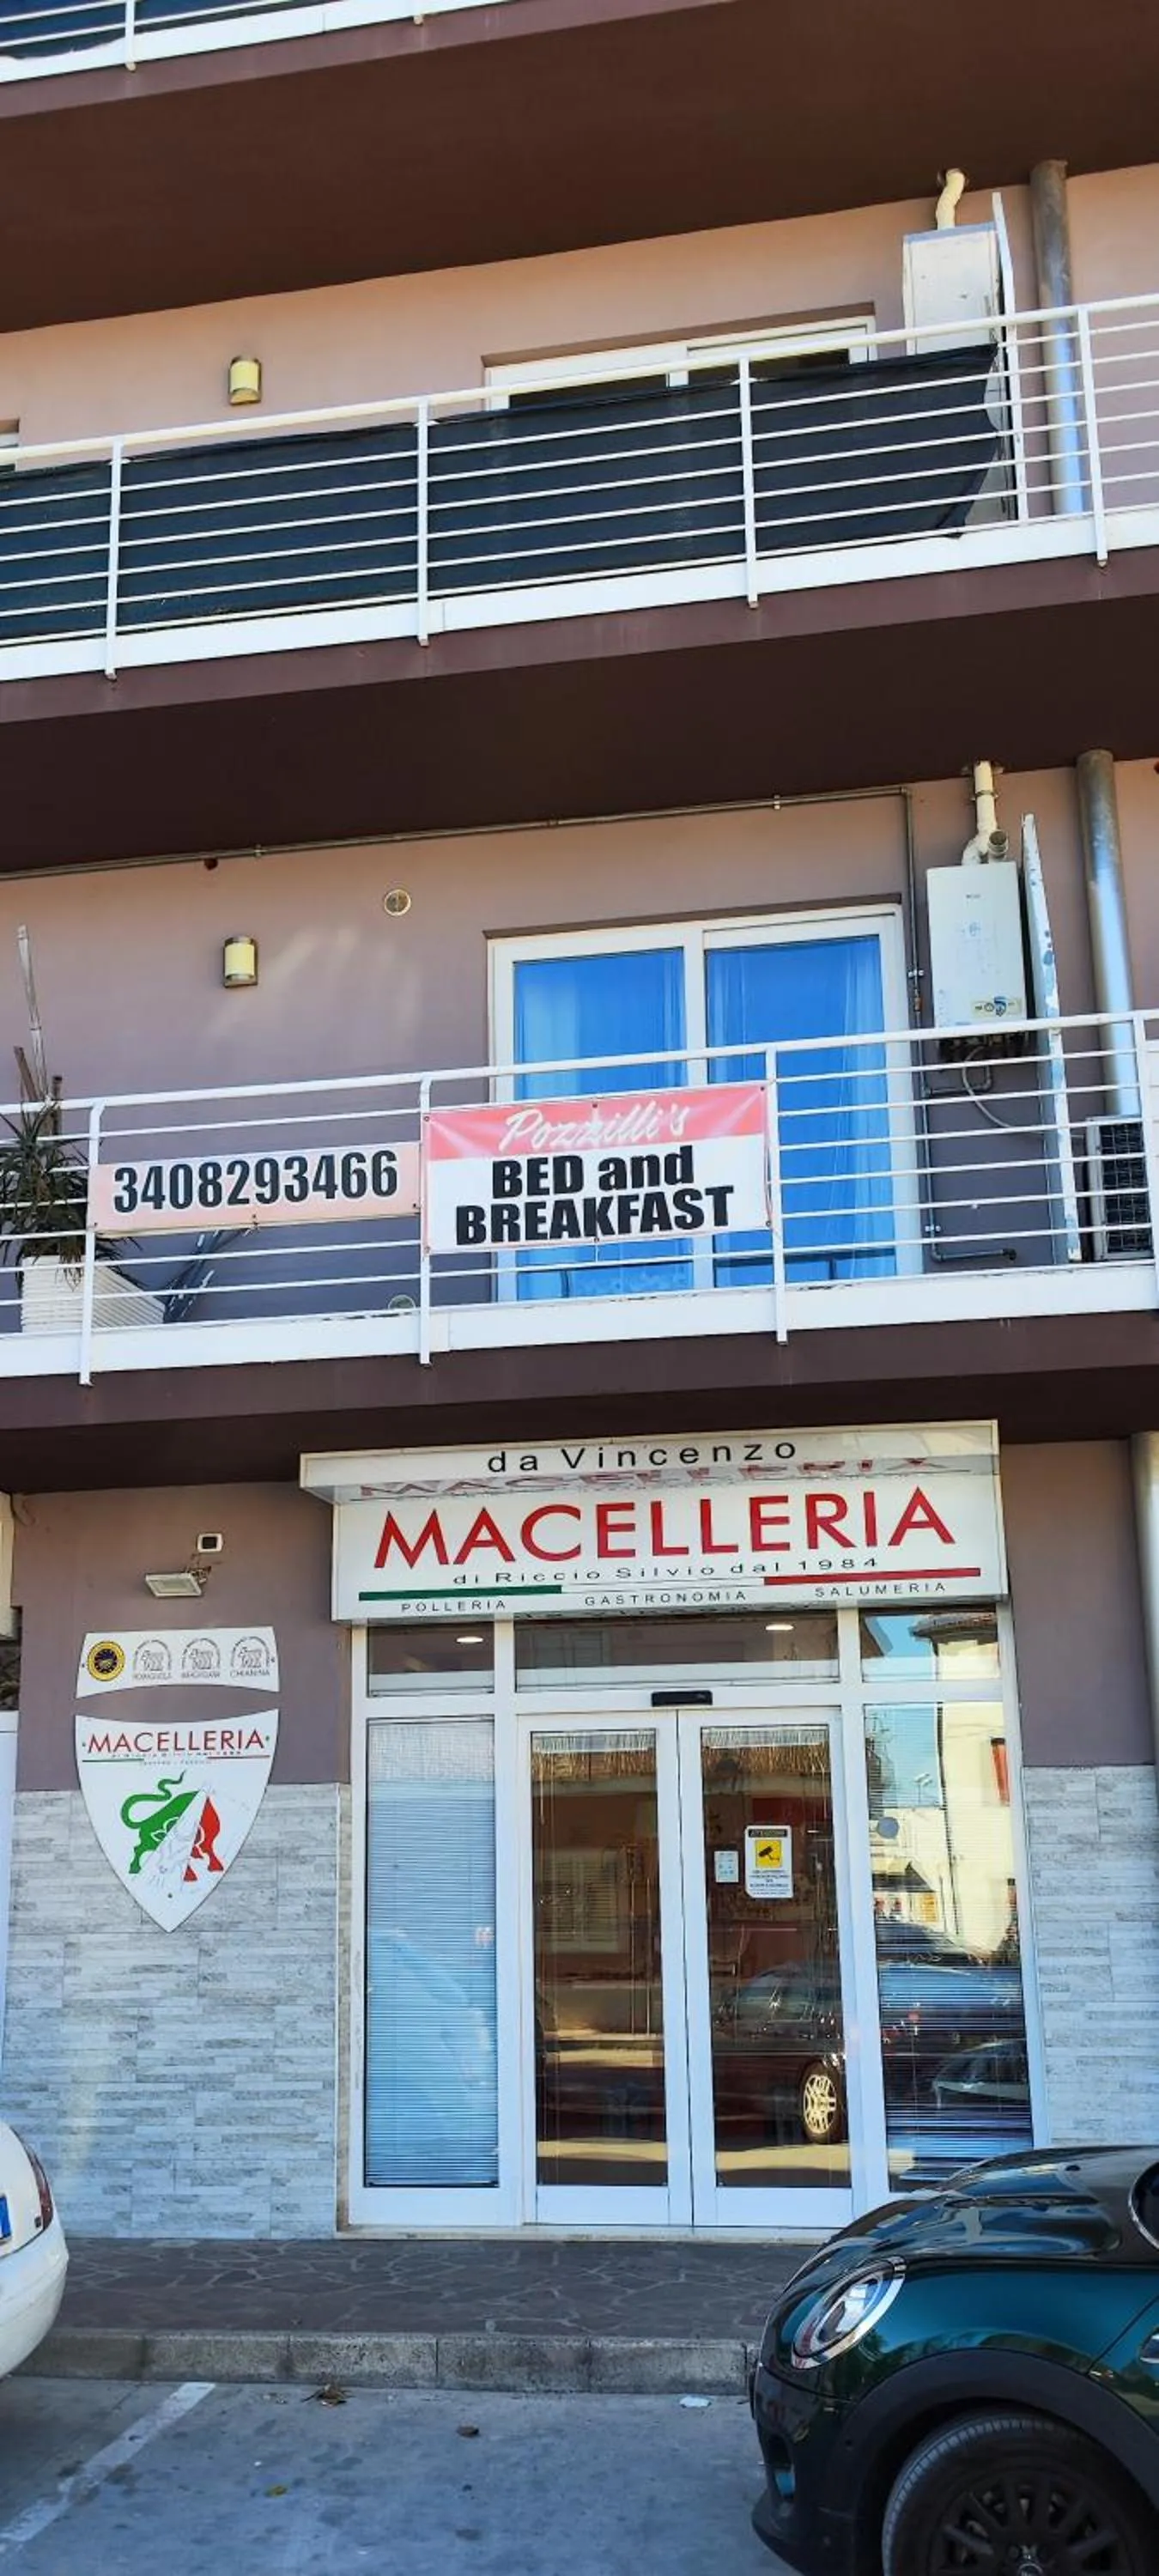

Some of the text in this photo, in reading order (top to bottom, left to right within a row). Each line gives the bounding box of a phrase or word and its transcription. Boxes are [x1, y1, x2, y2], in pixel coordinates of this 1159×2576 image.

[113, 1150, 398, 1214] 3408293466
[491, 1145, 694, 1197] BED and
[454, 1185, 736, 1246] BREAKFAST
[488, 1451, 538, 1473] da
[561, 1442, 796, 1468] Vincenzo
[373, 1486, 956, 1569] MACELLERIA
[453, 1557, 878, 1585] di Riccio Silvio dal 1984
[400, 1600, 507, 1613] POLLERIA
[584, 1589, 747, 1607] GASTRONOMIA
[814, 1583, 947, 1599] SALUMERIA
[88, 1729, 264, 1753] MACELLERIA
